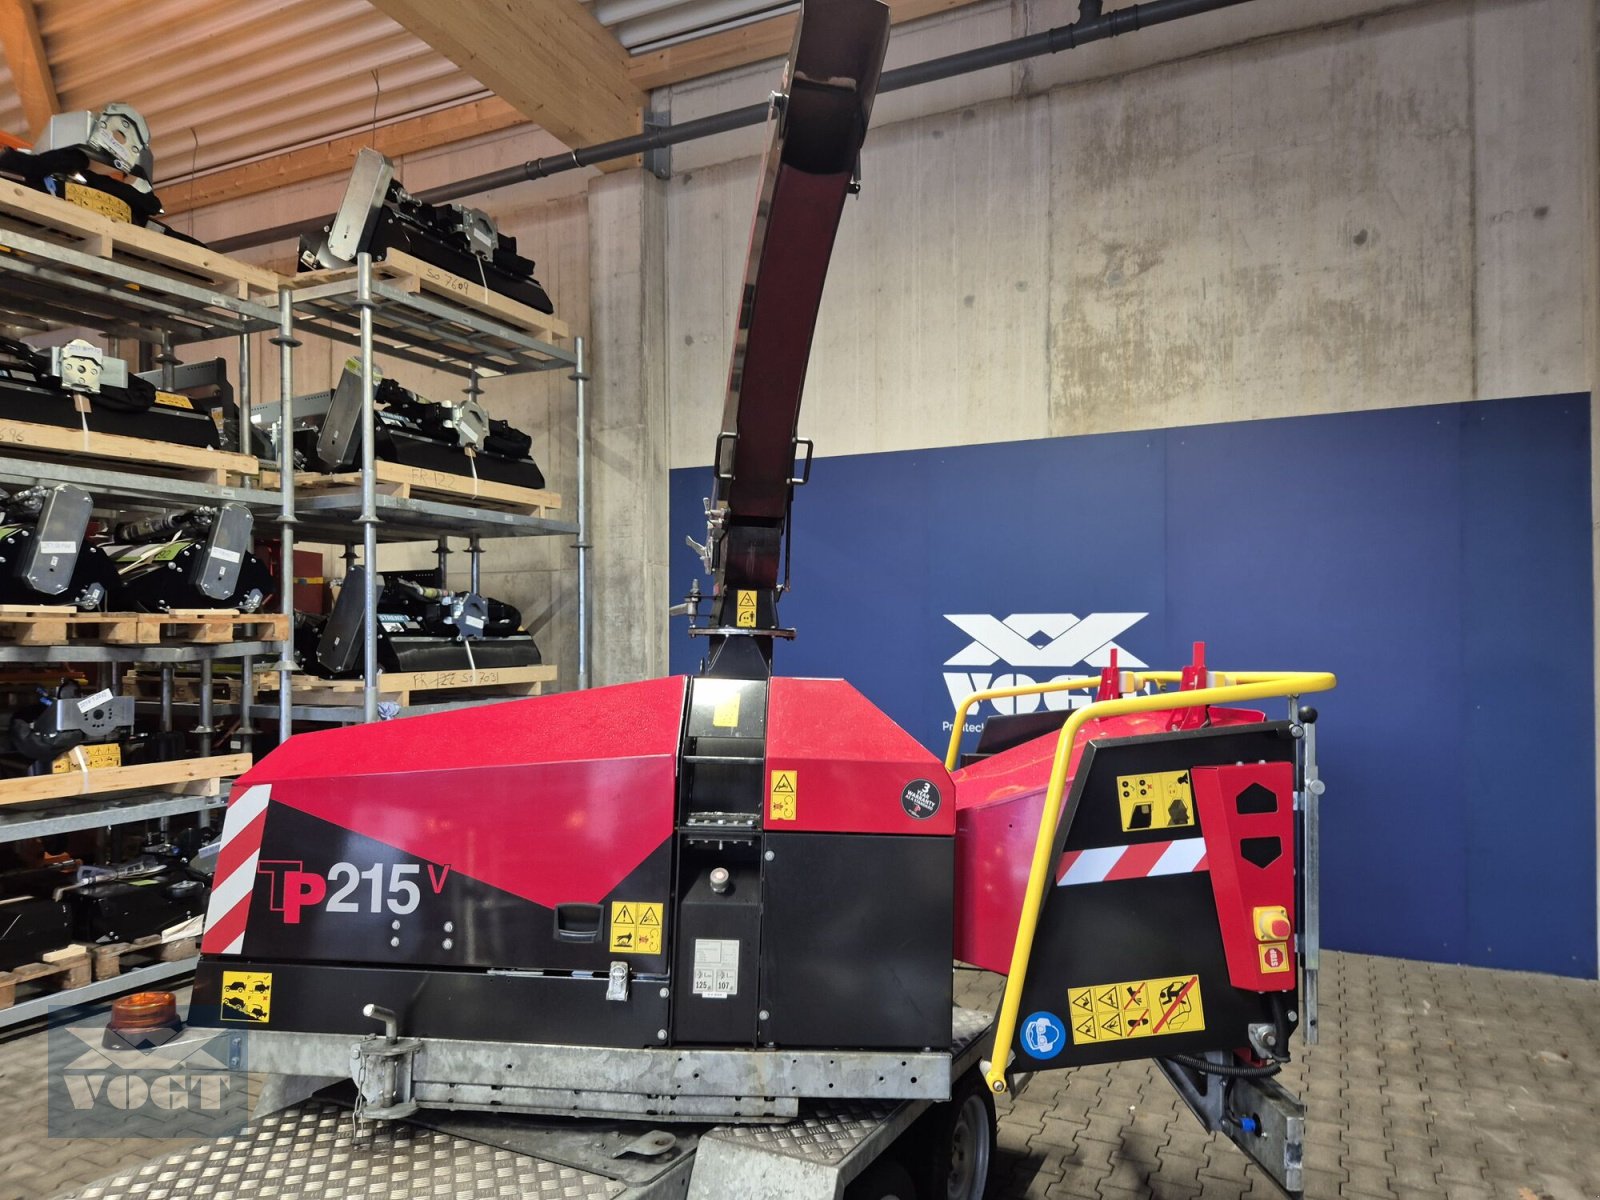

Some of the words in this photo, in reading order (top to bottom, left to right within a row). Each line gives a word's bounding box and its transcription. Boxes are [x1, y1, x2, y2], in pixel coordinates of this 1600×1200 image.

[922, 782, 930, 793] 3
[907, 790, 936, 807] WARRANTY
[917, 790, 930, 799] YEAR
[1270, 949, 1279, 967] STOP
[696, 981, 708, 989] 125
[718, 981, 730, 990] 107
